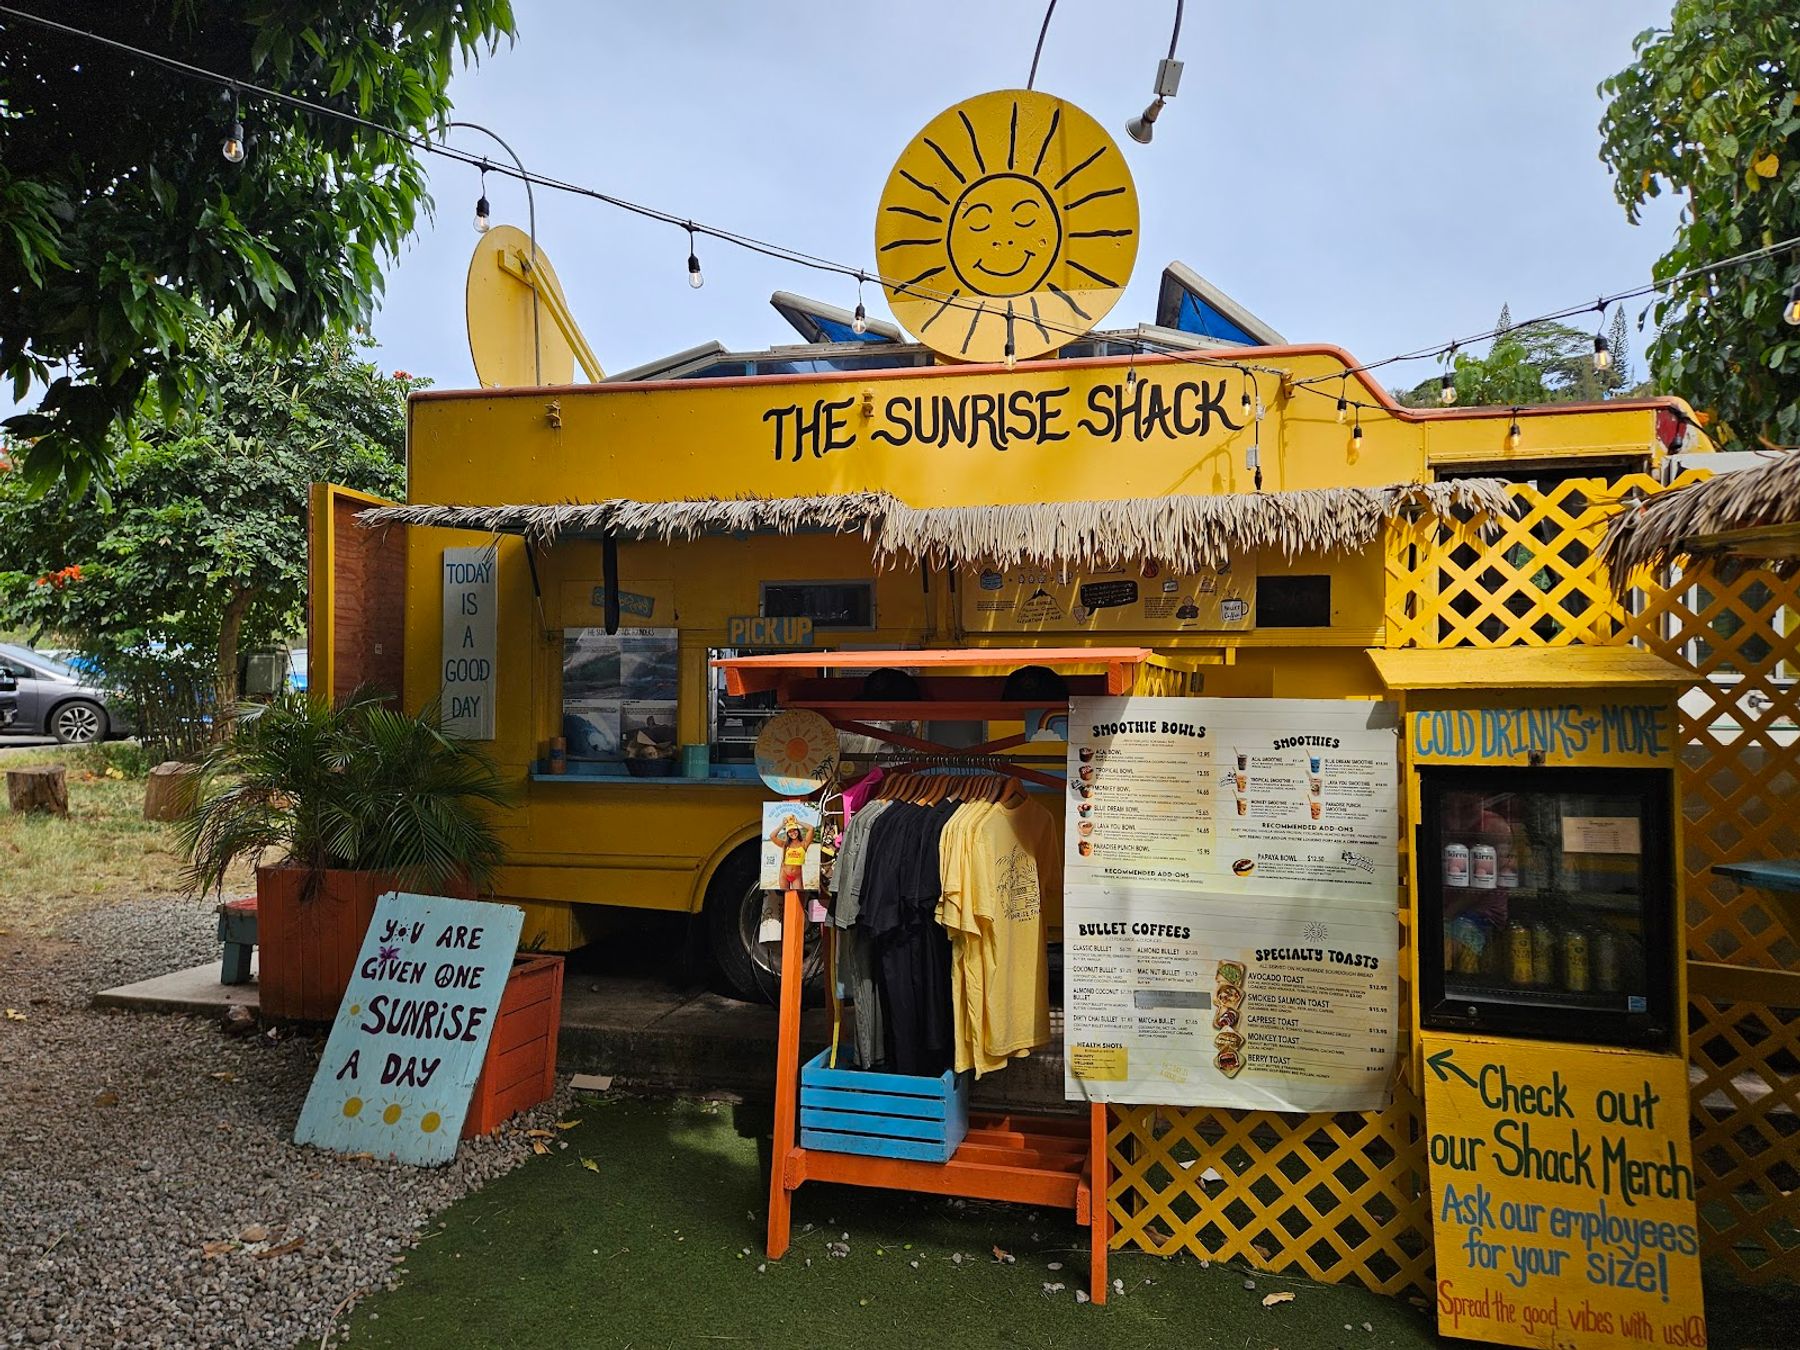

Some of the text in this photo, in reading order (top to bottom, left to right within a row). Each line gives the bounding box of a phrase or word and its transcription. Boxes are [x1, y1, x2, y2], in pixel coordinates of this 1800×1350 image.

[763, 377, 1244, 462] THE SUNRISE SHACK
[446, 562, 493, 584] TODAY
[461, 592, 478, 615] IS
[462, 625, 474, 648] A
[730, 618, 812, 645] PICK UP
[445, 658, 490, 682] GOOD
[452, 696, 481, 719] DAY
[1092, 721, 1207, 738] SMOOTHIE BOWLS
[1415, 710, 1475, 757] COLD
[1481, 704, 1589, 758] DRINKS
[1601, 704, 1669, 758] MORE
[1273, 735, 1340, 750] SMOOTHIES
[1262, 822, 1353, 832] RECOMMENDED ADD-ONS
[1257, 853, 1297, 862] PAPAYA BOWL
[1104, 868, 1156, 876] RECOMMENDED
[436, 925, 484, 950] ARE
[1078, 922, 1191, 939] BULLET COFFEES
[1255, 948, 1379, 970] SPECIALTY TOASTS
[361, 955, 485, 989] GIVEN ONE
[1247, 973, 1304, 984] AVOCADO TOAST
[1325, 969, 1356, 977] SOURDOUGH
[1247, 994, 1330, 1009] SMOKED SALMON TOAST
[1247, 1015, 1299, 1027] CAPRESE TOAST
[1076, 1041, 1101, 1049] HEALTH
[1247, 1032, 1300, 1045] MONKEY TOAST
[336, 1049, 441, 1087] A DAY
[1247, 1053, 1291, 1065] BERRY TOAST
[1479, 1063, 1661, 1129] Check out
[1430, 1119, 1696, 1207] our Shack Merch
[1441, 1183, 1699, 1261] Ask our employees
[1462, 1226, 1670, 1304] for your size!
[1438, 1279, 1490, 1329] Spread
[1491, 1289, 1516, 1323] the
[1521, 1297, 1559, 1335] good
[1568, 1301, 1614, 1335] vibes
[1620, 1311, 1654, 1343] with
